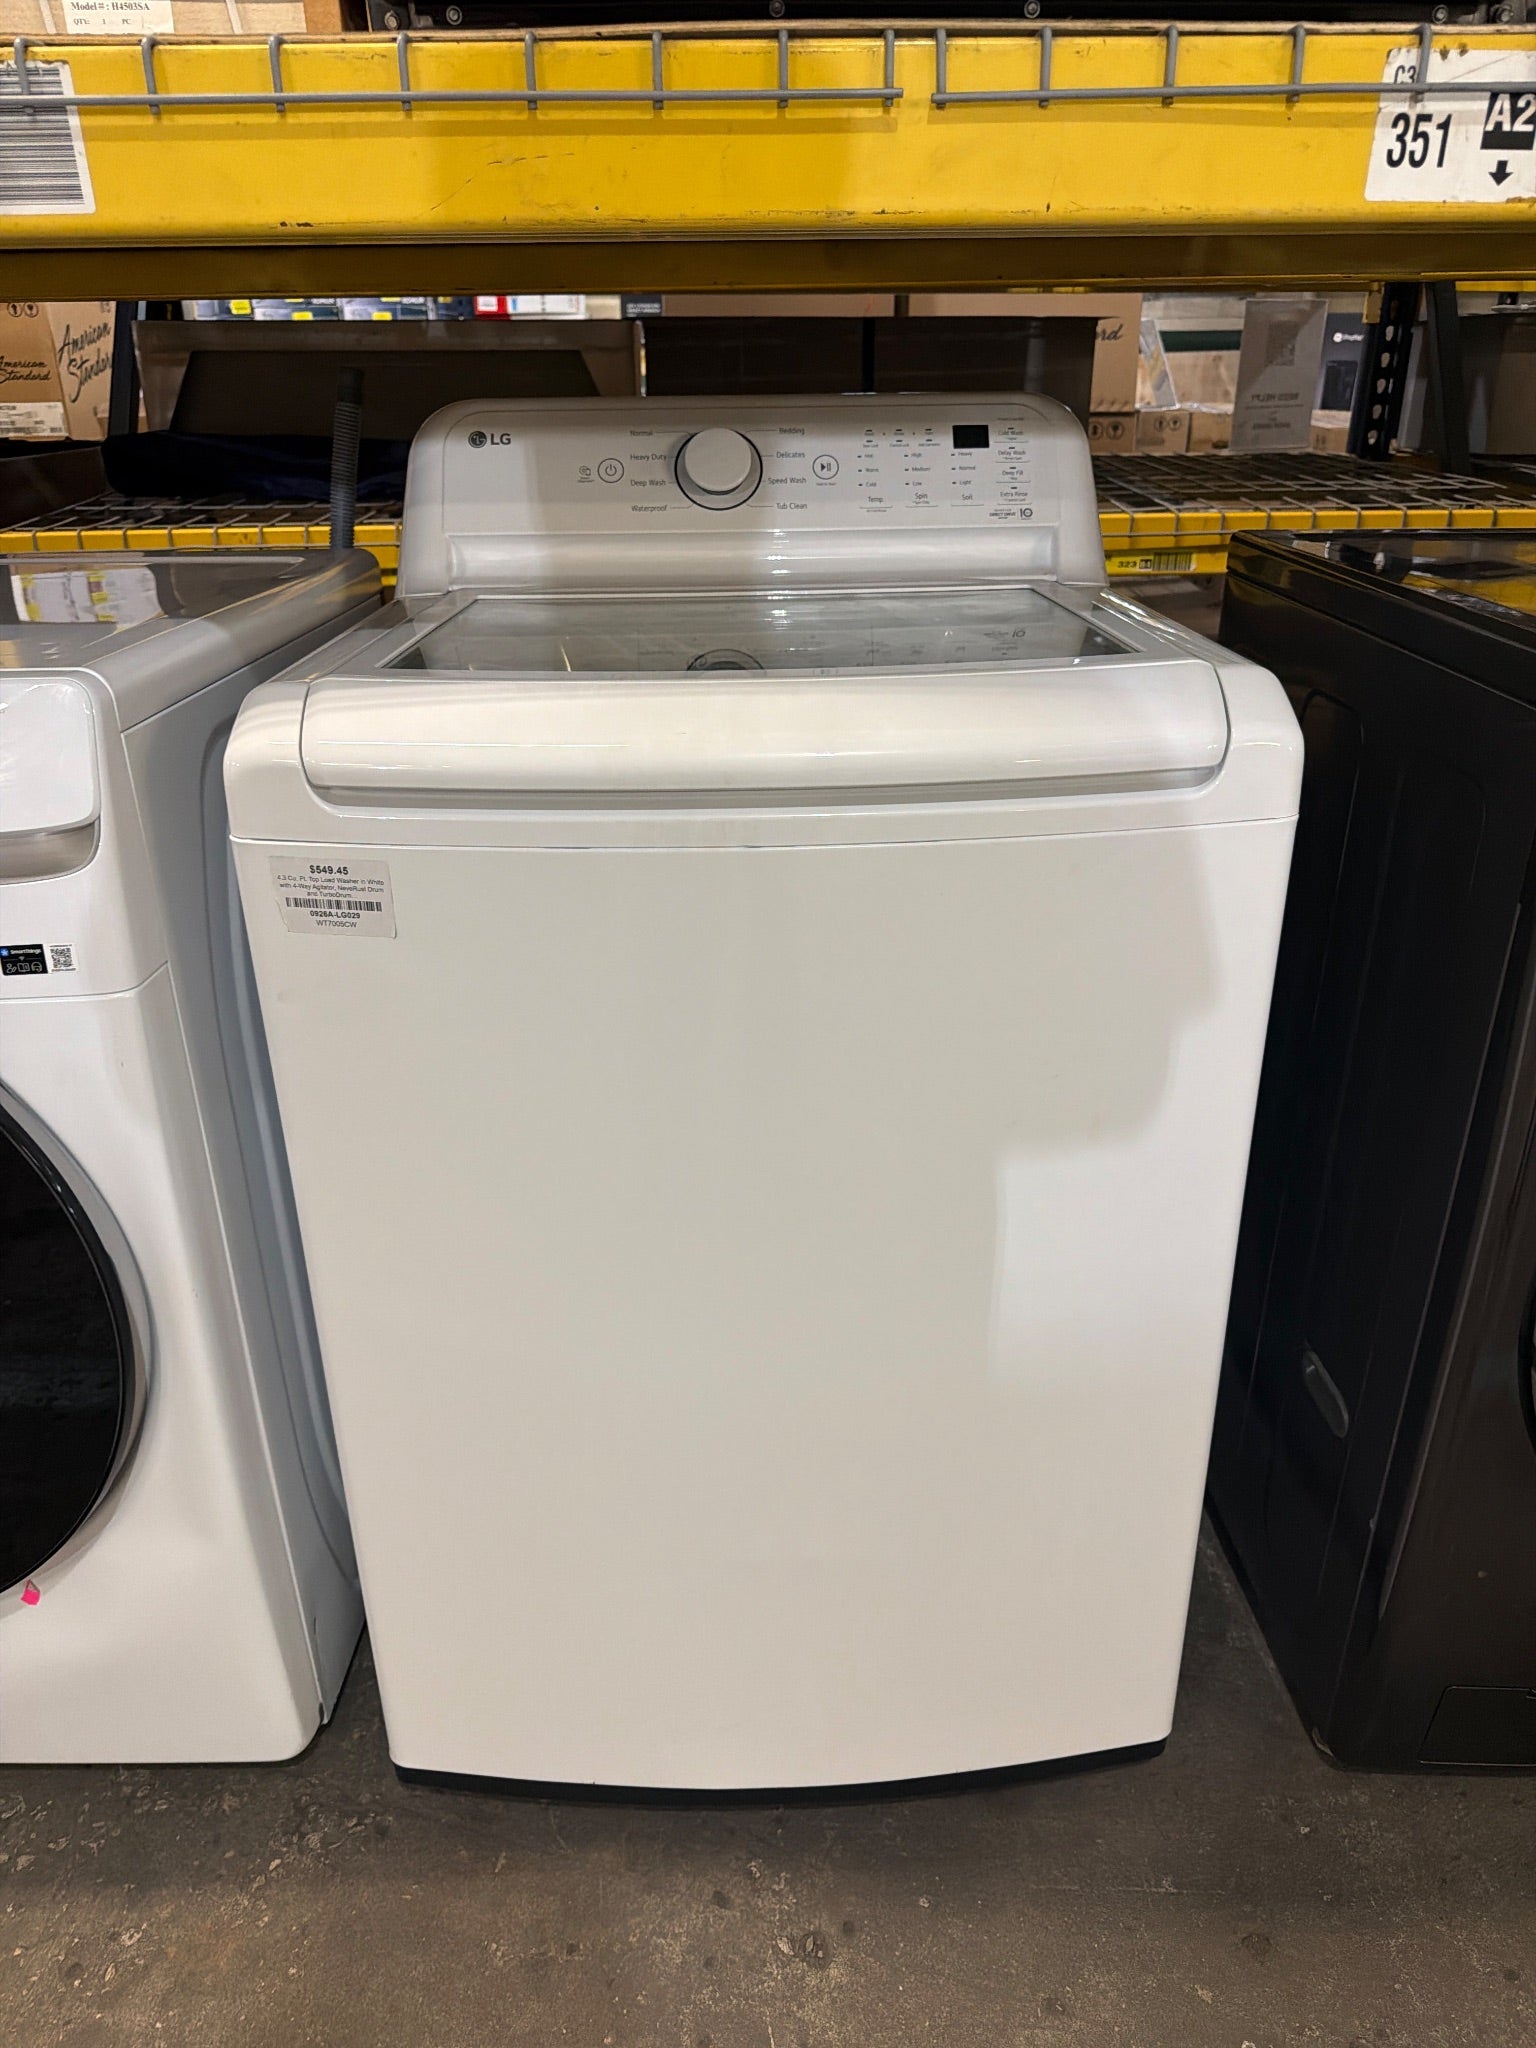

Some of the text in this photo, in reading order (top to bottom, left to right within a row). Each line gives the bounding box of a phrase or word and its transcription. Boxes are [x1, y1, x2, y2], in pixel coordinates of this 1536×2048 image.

[112, 2, 150, 11] H4503SA
[1484, 92, 1536, 132] A2
[1386, 112, 1453, 169] 351
[67, 347, 112, 403] Standar
[490, 433, 512, 446] LG
[630, 453, 667, 461] Heavy Duty
[776, 451, 806, 459] Delicates
[630, 479, 648, 487] Deep
[767, 477, 788, 485] Speed
[914, 492, 928, 501] Spin
[631, 504, 668, 513] Waterproof
[775, 502, 808, 510] Tub Clean
[309, 864, 349, 876] $549.45
[309, 876, 319, 884] Top
[336, 877, 360, 885] Washer
[292, 882, 312, 891] 4-Way
[316, 919, 358, 929] WT7005CW
